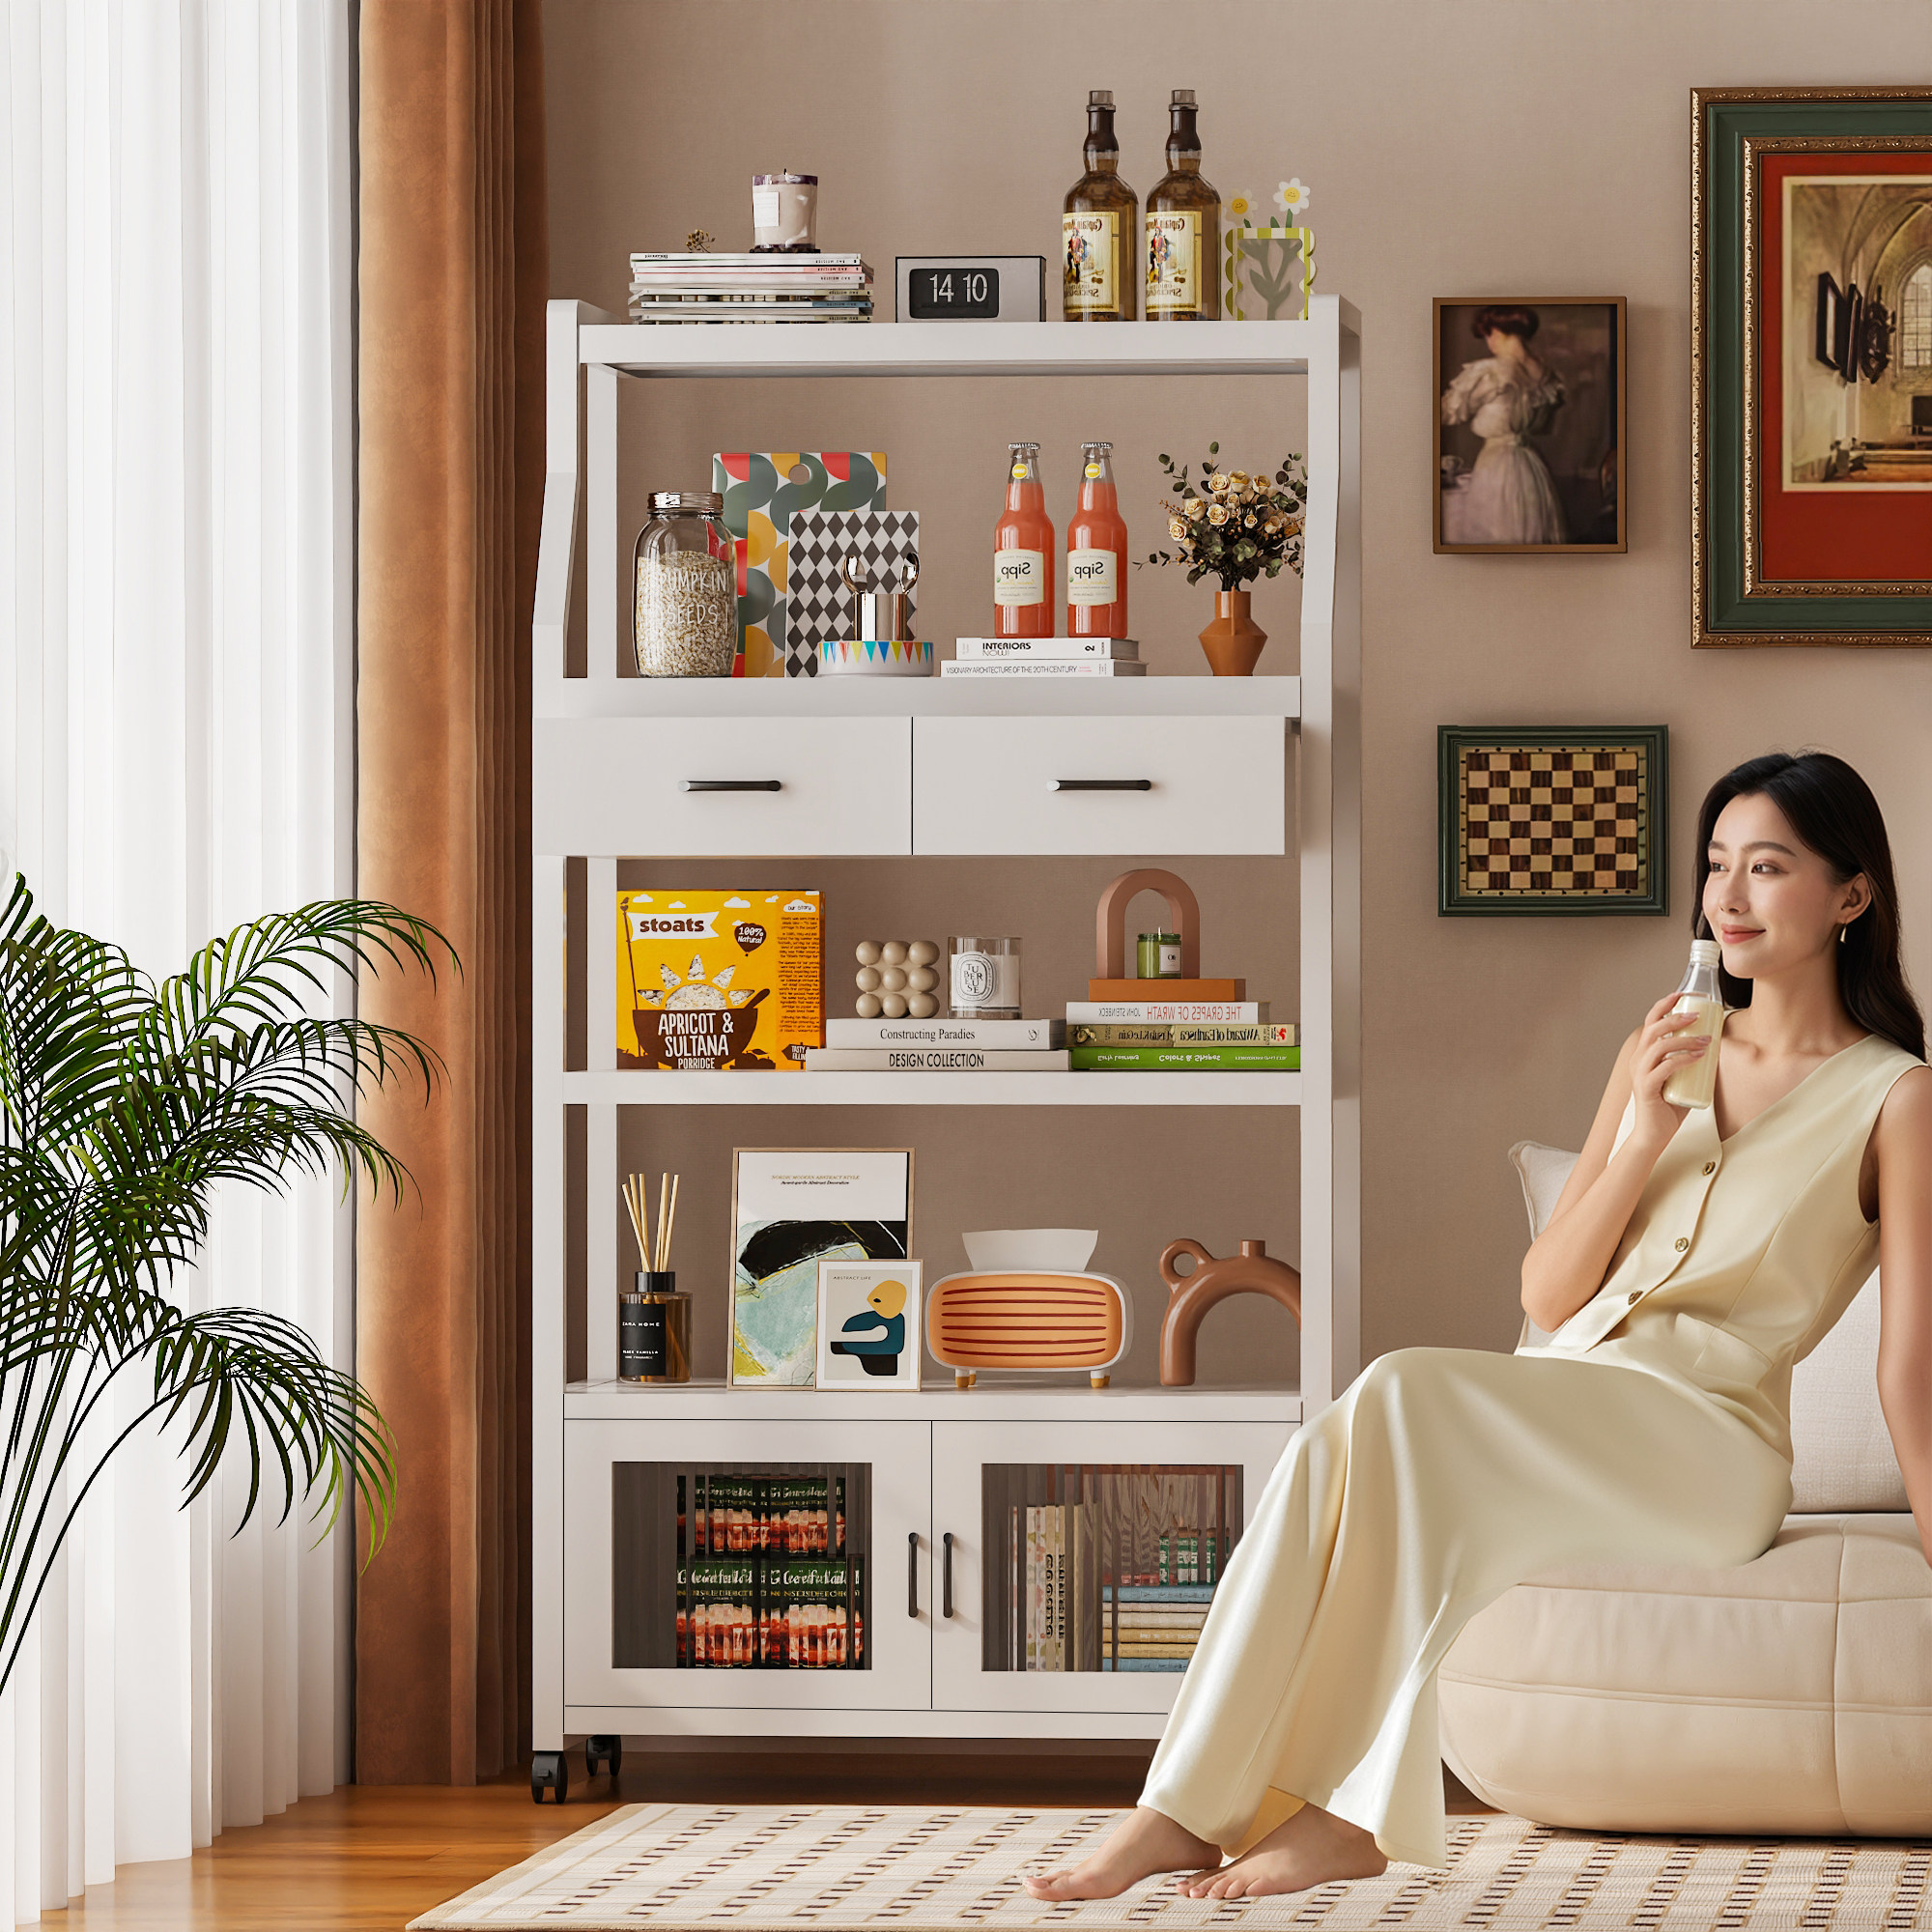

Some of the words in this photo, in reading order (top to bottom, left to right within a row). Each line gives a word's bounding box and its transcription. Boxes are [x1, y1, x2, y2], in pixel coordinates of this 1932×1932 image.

[929, 273, 954, 302] 14
[962, 273, 987, 302] 10
[658, 570, 726, 591] PUMPKIN
[667, 604, 718, 625] SEEDS
[639, 918, 704, 933] stoats
[738, 926, 764, 937] 100%
[737, 935, 762, 944] Natural
[658, 1012, 716, 1036] APRICOT
[722, 1012, 734, 1034] &
[880, 1028, 936, 1042] Constructing
[939, 1029, 975, 1039] Paradies
[665, 1034, 728, 1057] SULTANA
[678, 1057, 715, 1069] PORRIDGE
[889, 1053, 923, 1067] DESIGN
[926, 1053, 984, 1067] COLLECTION
